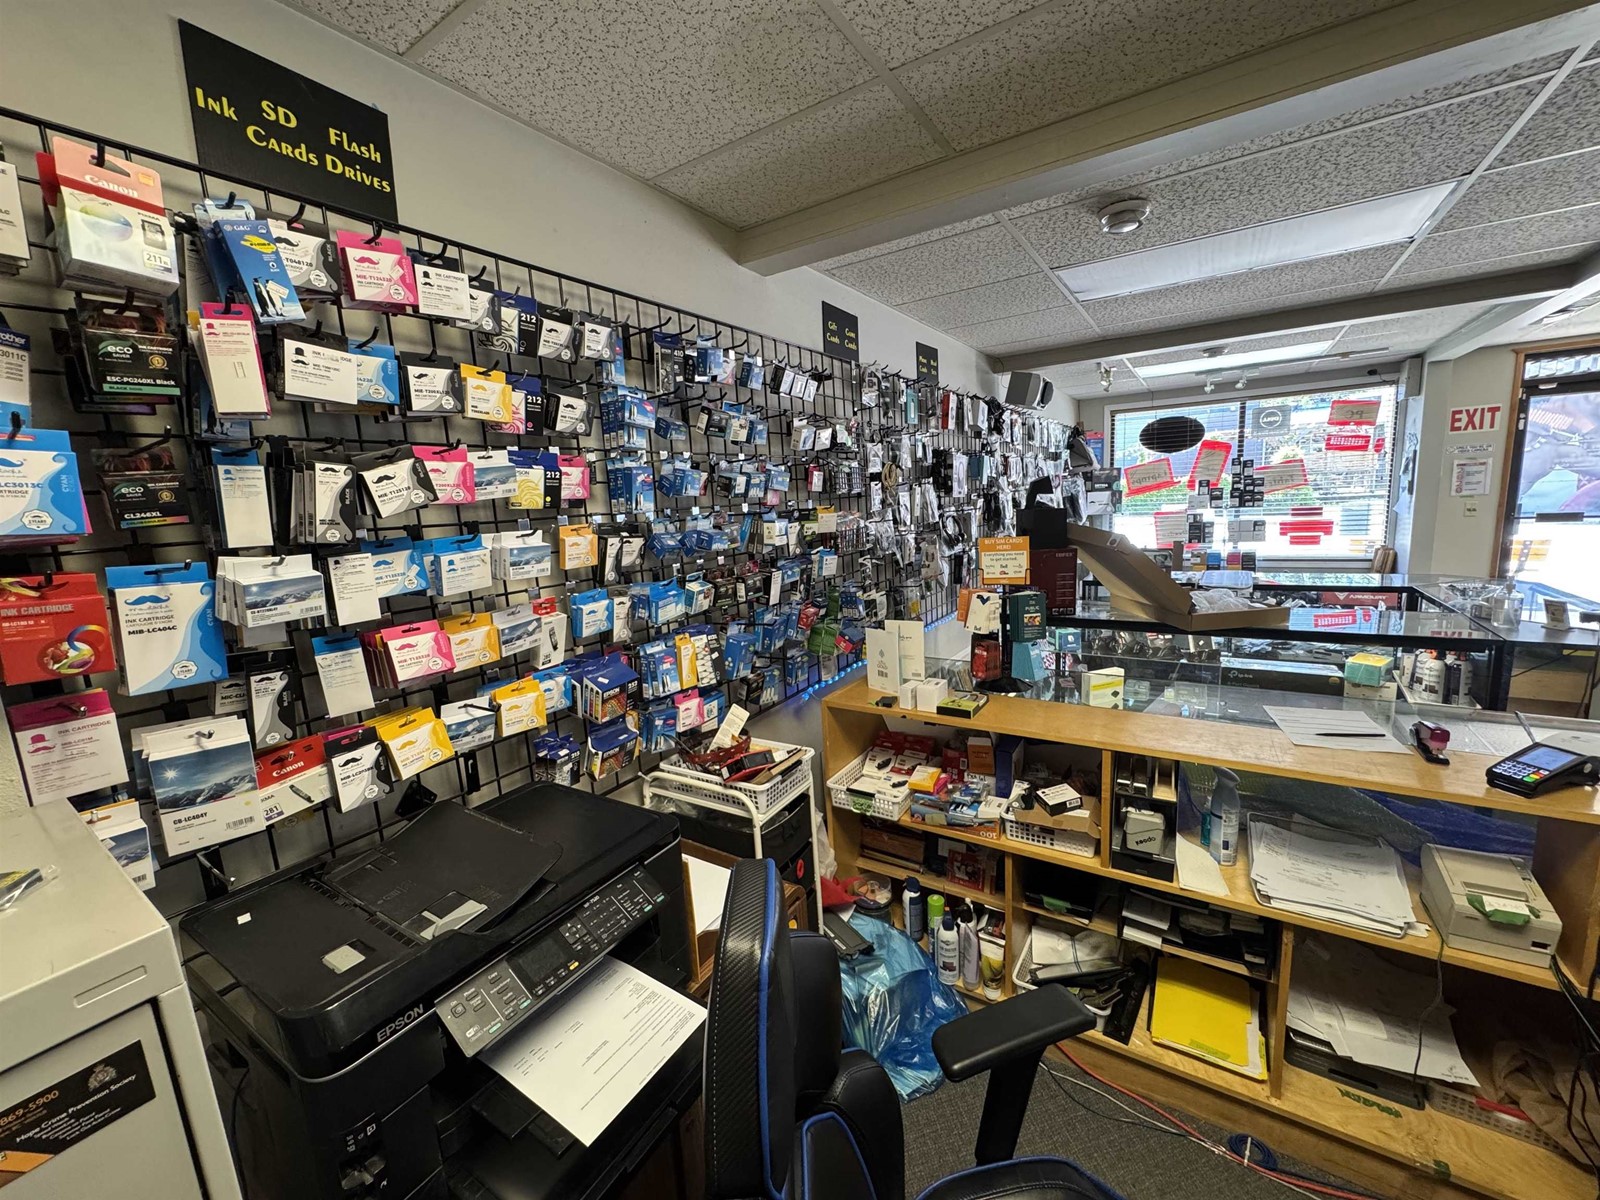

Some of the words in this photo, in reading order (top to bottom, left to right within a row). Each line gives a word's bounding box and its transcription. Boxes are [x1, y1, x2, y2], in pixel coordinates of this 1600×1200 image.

[261, 100, 298, 128] SD
[246, 125, 319, 166] Cards
[329, 127, 382, 164] Flash
[325, 153, 391, 193] Drives
[84, 174, 138, 198] Canon
[146, 252, 162, 265] 211
[520, 313, 536, 322] 212
[107, 344, 132, 354] eco
[0, 350, 26, 362] 3011C
[527, 396, 542, 404] 212
[1450, 406, 1501, 432] EXIT
[415, 463, 424, 478] BLACK
[122, 486, 144, 494] eco
[1, 608, 18, 617] INK
[21, 604, 74, 615] CARTRIDGE
[128, 625, 177, 635] MIB-LC404C
[603, 687, 620, 698] EPSON
[72, 720, 111, 732] CARTRIDGE
[603, 748, 620, 758] EPSON
[272, 761, 304, 777] Canon
[264, 806, 279, 816] 281
[173, 812, 208, 825] CB-LC404Y
[980, 831, 997, 839] 100
[377, 1004, 424, 1042] EPSON
[0, 1090, 59, 1126] 869-5900
[16, 1127, 40, 1143] Hope
[42, 1112, 67, 1128] Crime
[68, 1089, 109, 1114] Prevention
[110, 1074, 136, 1091] Society
